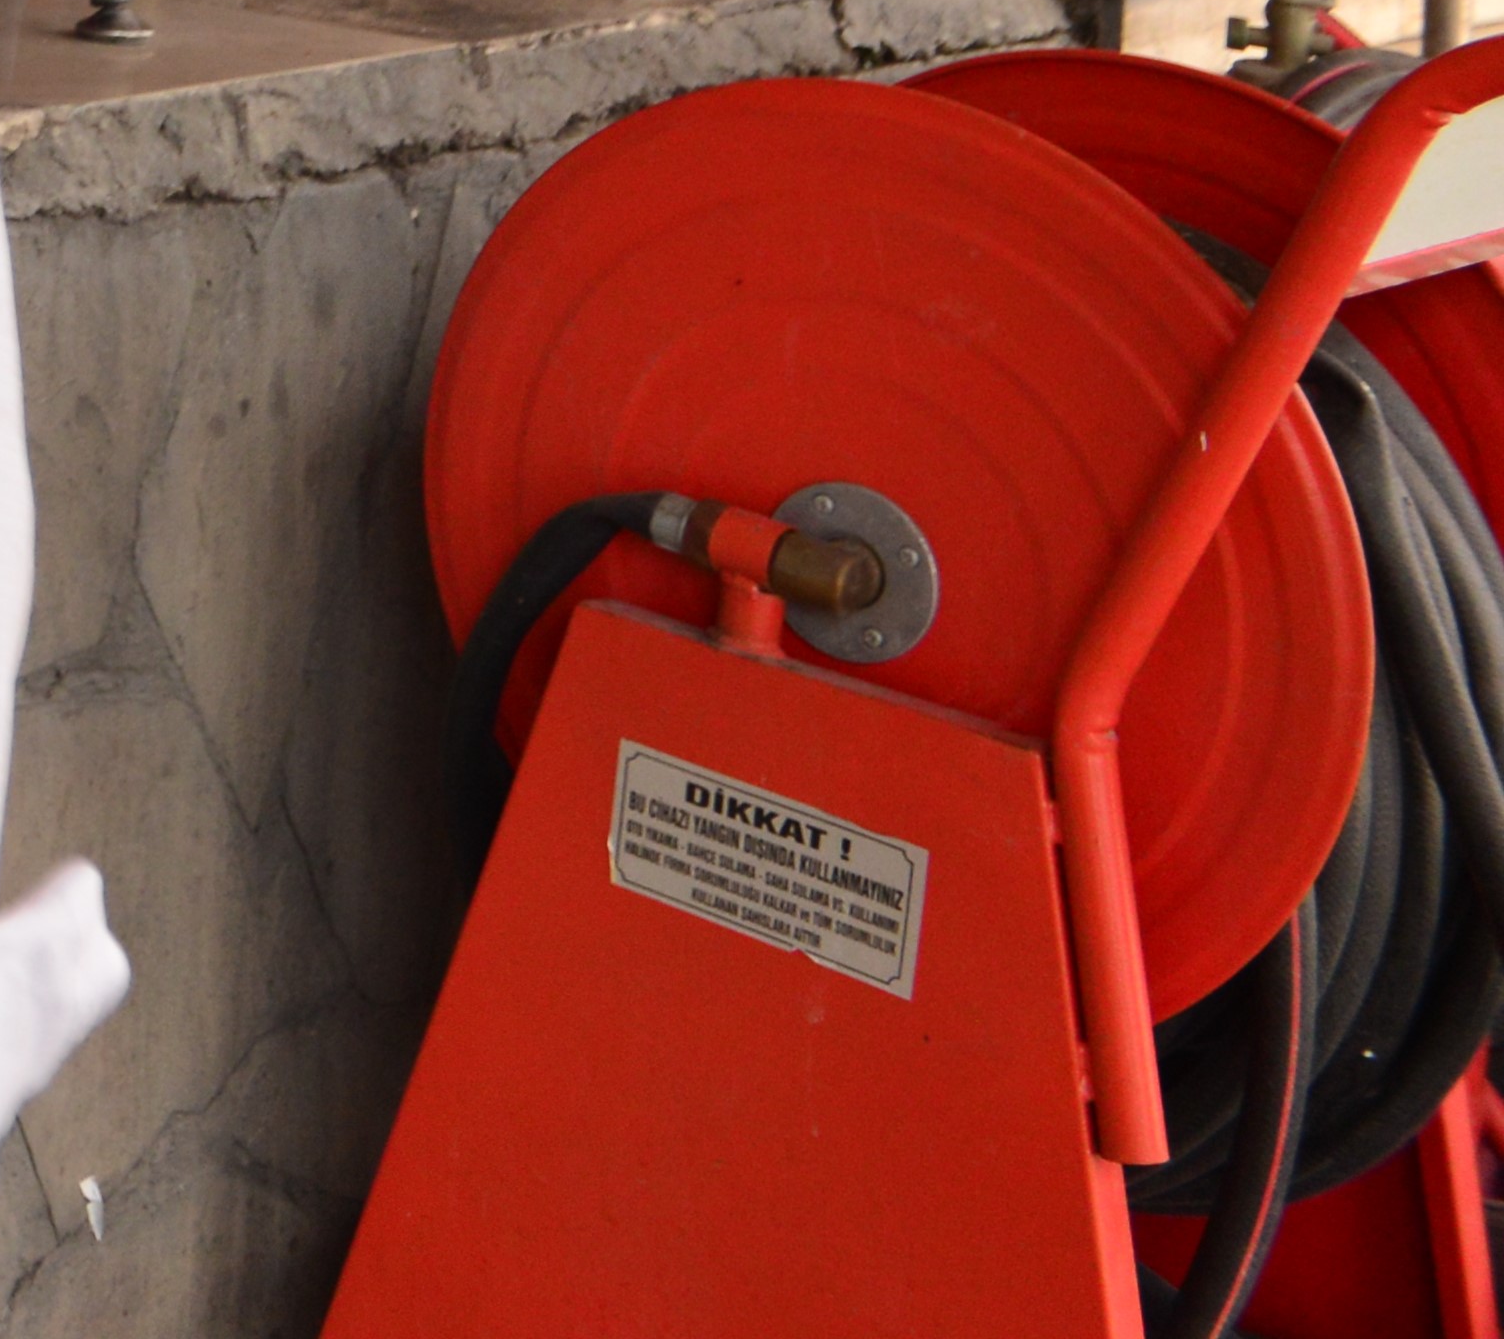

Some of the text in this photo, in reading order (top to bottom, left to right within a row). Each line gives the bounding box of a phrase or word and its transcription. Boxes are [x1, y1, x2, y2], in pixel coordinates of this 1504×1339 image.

[628, 790, 646, 814] BU
[693, 814, 740, 850] YANGIN
[744, 832, 796, 870] DIŞINDA
[799, 853, 904, 911] KULLANMAYINIZ
[685, 781, 828, 851] DİKKAT
[718, 853, 756, 879] SULAMA
